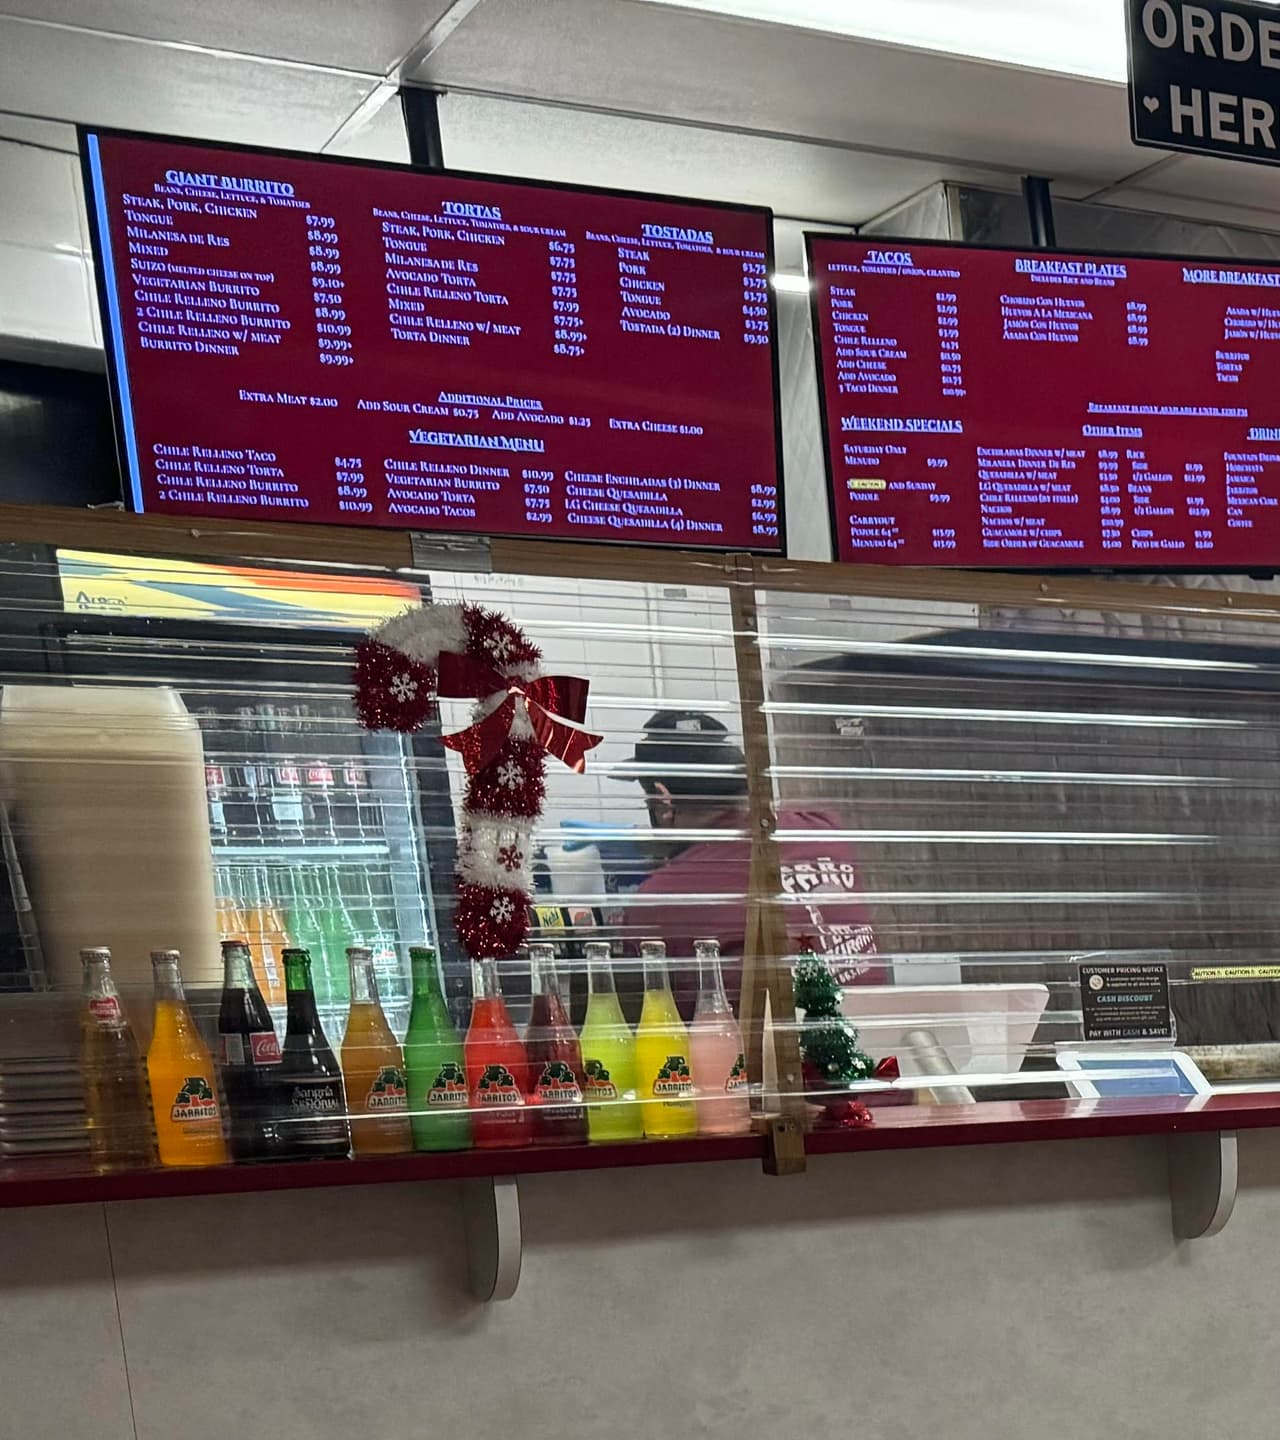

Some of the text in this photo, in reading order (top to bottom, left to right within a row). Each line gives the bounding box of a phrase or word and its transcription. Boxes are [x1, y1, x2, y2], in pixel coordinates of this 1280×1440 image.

[165, 169, 294, 197] GIANT BURRITO
[122, 193, 257, 218] STEAK, PORK, CHICKEN
[441, 201, 501, 220] TORTAS
[123, 209, 173, 225] TONGUE
[126, 225, 229, 246] MILANESA DE RES
[640, 223, 713, 244] TOSTADAS
[128, 241, 168, 255] MIXED
[867, 250, 913, 266] TACOS
[130, 257, 165, 271] SUIZO
[167, 263, 205, 274] (MELTED
[206, 268, 238, 278] CHEESE
[254, 272, 274, 282] TOP)
[1015, 258, 1126, 278] BREAKFAST PLATES
[1182, 267, 1218, 283] MORE
[131, 273, 259, 295] VEGETARIAN BURRITO
[134, 289, 279, 313] CHILE RELLENO BURRITO
[136, 306, 290, 328] 2 CHILE RELLENO BURRITO
[137, 321, 281, 343] CHILE RELLENO W/ MEAT
[140, 335, 239, 355] BURRITO DINNER
[841, 415, 962, 433] WEEKEND SPECIALS
[408, 428, 544, 452] VEGETARIAN MENU
[1192, 968, 1216, 976] AUTION
[1096, 994, 1153, 1003] CASH DISCOUNT
[172, 1106, 218, 1120] JARRITOS
